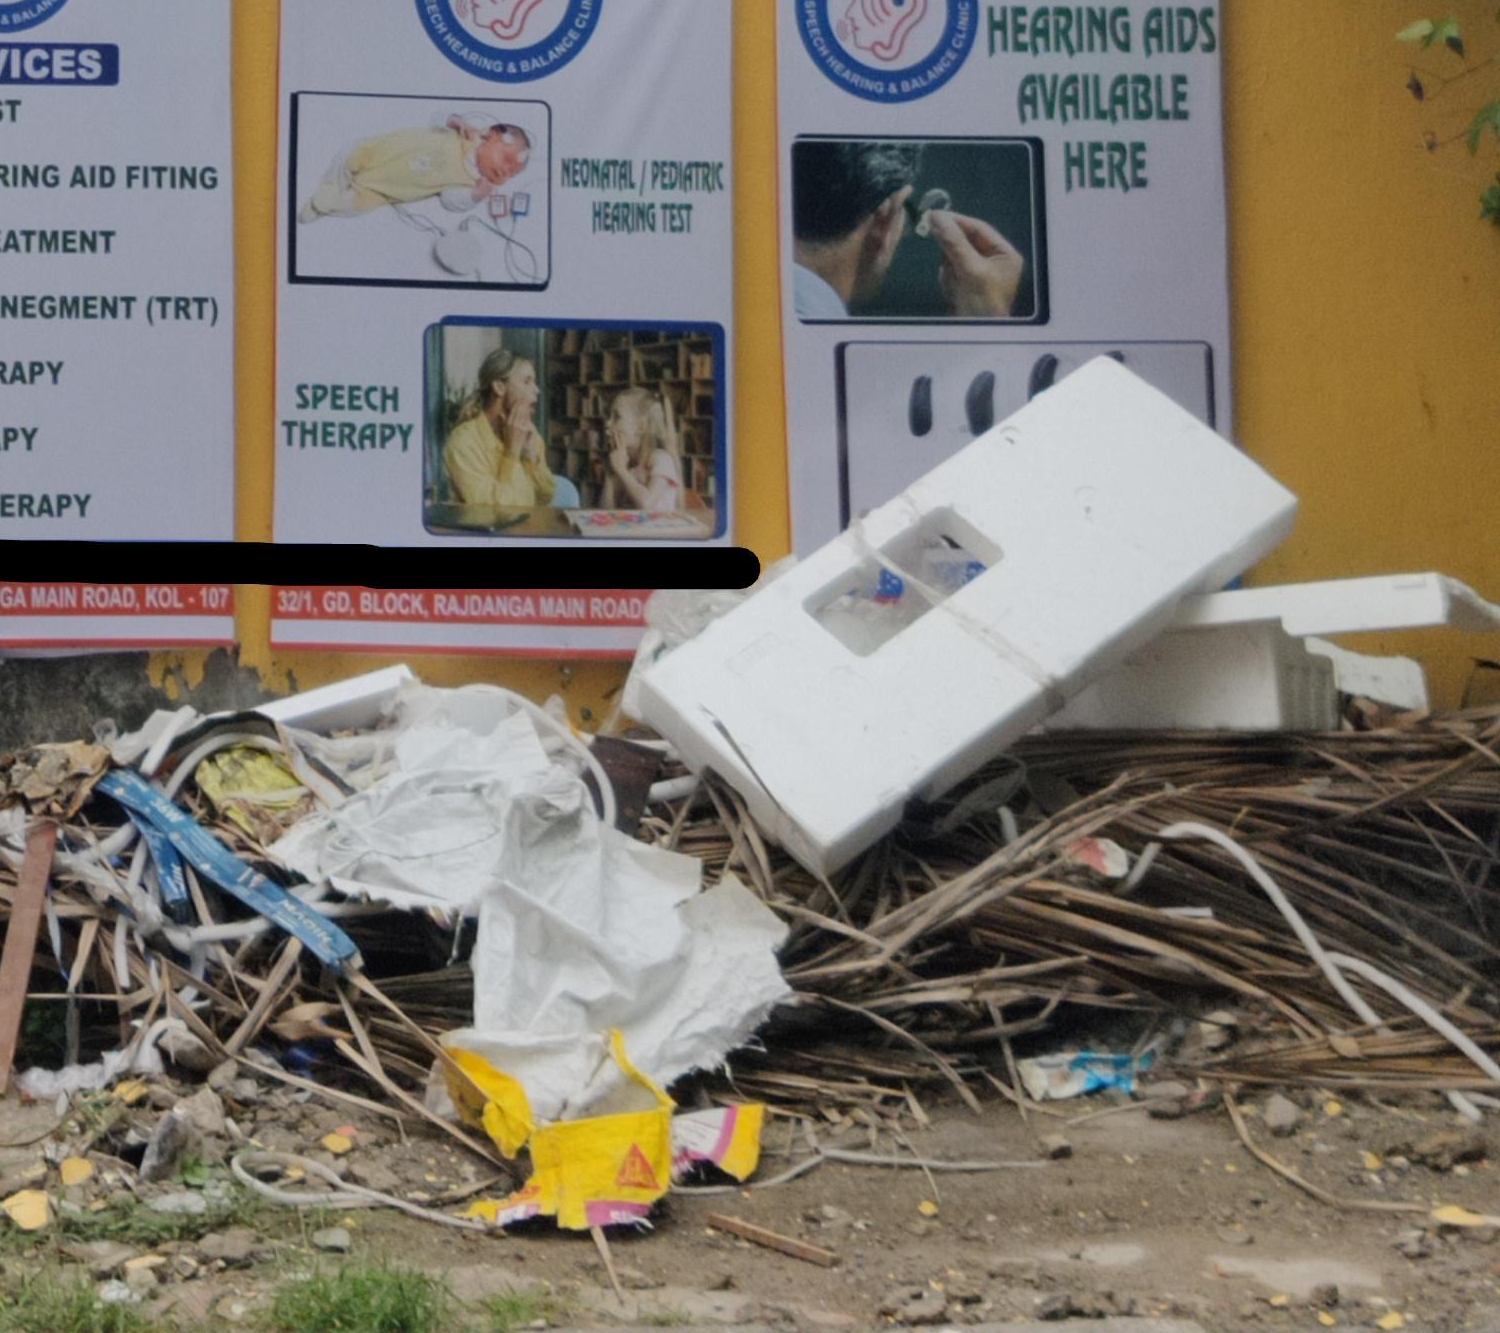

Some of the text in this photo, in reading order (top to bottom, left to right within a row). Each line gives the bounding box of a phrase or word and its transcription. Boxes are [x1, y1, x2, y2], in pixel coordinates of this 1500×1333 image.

[0, 13, 10, 25] &
[987, 5, 1217, 58] HEARING AIDS
[443, 32, 503, 73] HEARING
[506, 61, 518, 74] &
[520, 27, 580, 73] BALANCE
[804, 0, 971, 95] SPEECH HEARING & BALANCE CLINIC
[1017, 73, 1189, 126] AVAILABLE
[69, 166, 116, 189] AID
[126, 166, 219, 190] FITING
[561, 157, 636, 191] NEONATAL
[651, 160, 724, 193] PEDIATRIC
[1064, 141, 1148, 194] HERE
[592, 201, 693, 233] HEARING TEST
[146, 296, 219, 327] (TRT)
[296, 383, 399, 414] SPEECH
[281, 420, 414, 453] THERAPY
[31, 587, 80, 609] MAIN
[84, 587, 139, 612] ROAD,
[145, 587, 183, 609] KOL
[200, 587, 229, 609] 107
[277, 590, 318, 615] 32/1,
[323, 591, 356, 616] GD,
[360, 592, 429, 618] BLOCK,
[434, 593, 535, 617] RAJDANGA
[539, 596, 586, 618] MAIN
